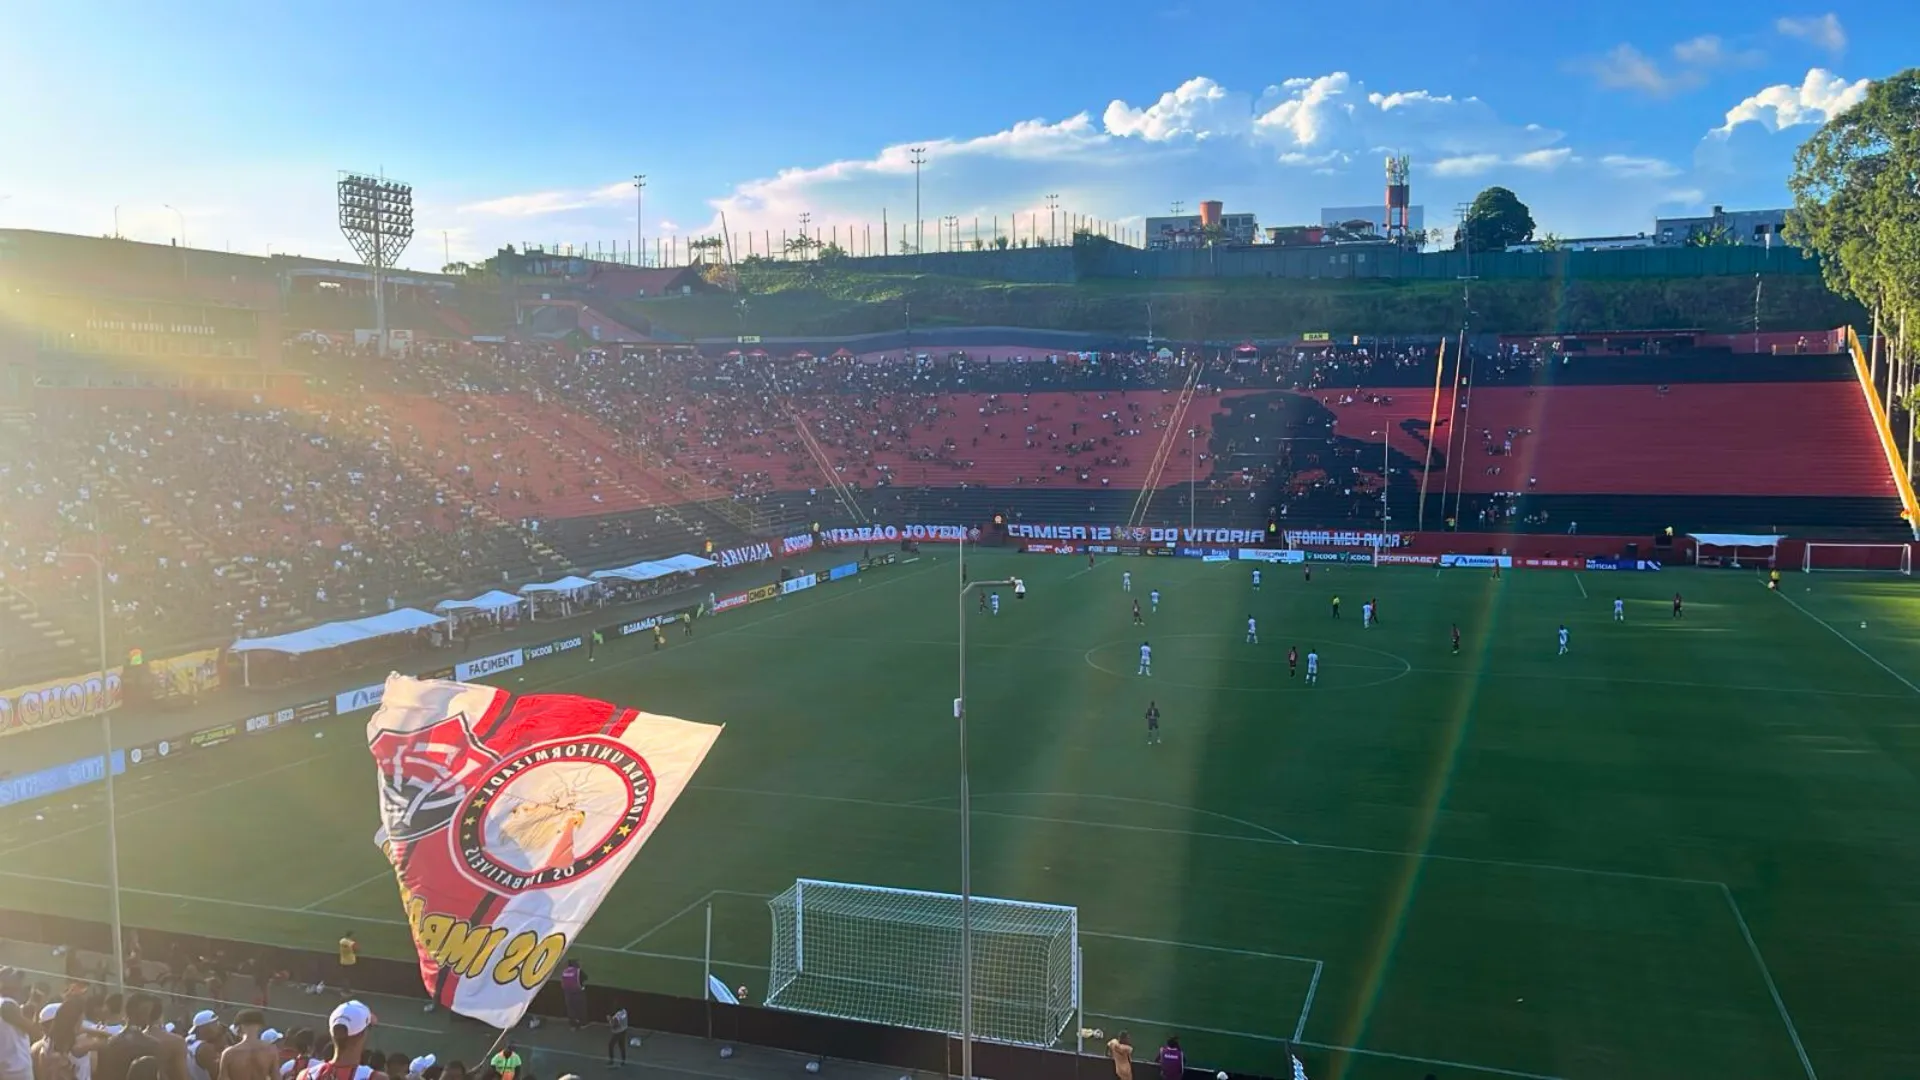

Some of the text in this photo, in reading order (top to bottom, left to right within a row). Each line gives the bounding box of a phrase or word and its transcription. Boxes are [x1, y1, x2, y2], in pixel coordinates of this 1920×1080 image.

[902, 525, 968, 540] JOVEM
[1007, 524, 1087, 540] CAMISA
[1090, 527, 1112, 541] 12
[1150, 528, 1178, 542] DO
[1333, 532, 1360, 546] MEU
[1363, 533, 1400, 548] AMOR
[530, 645, 552, 658] SICOOB
[560, 637, 581, 651] SICOOB
[468, 654, 515, 676] FACIMENT
